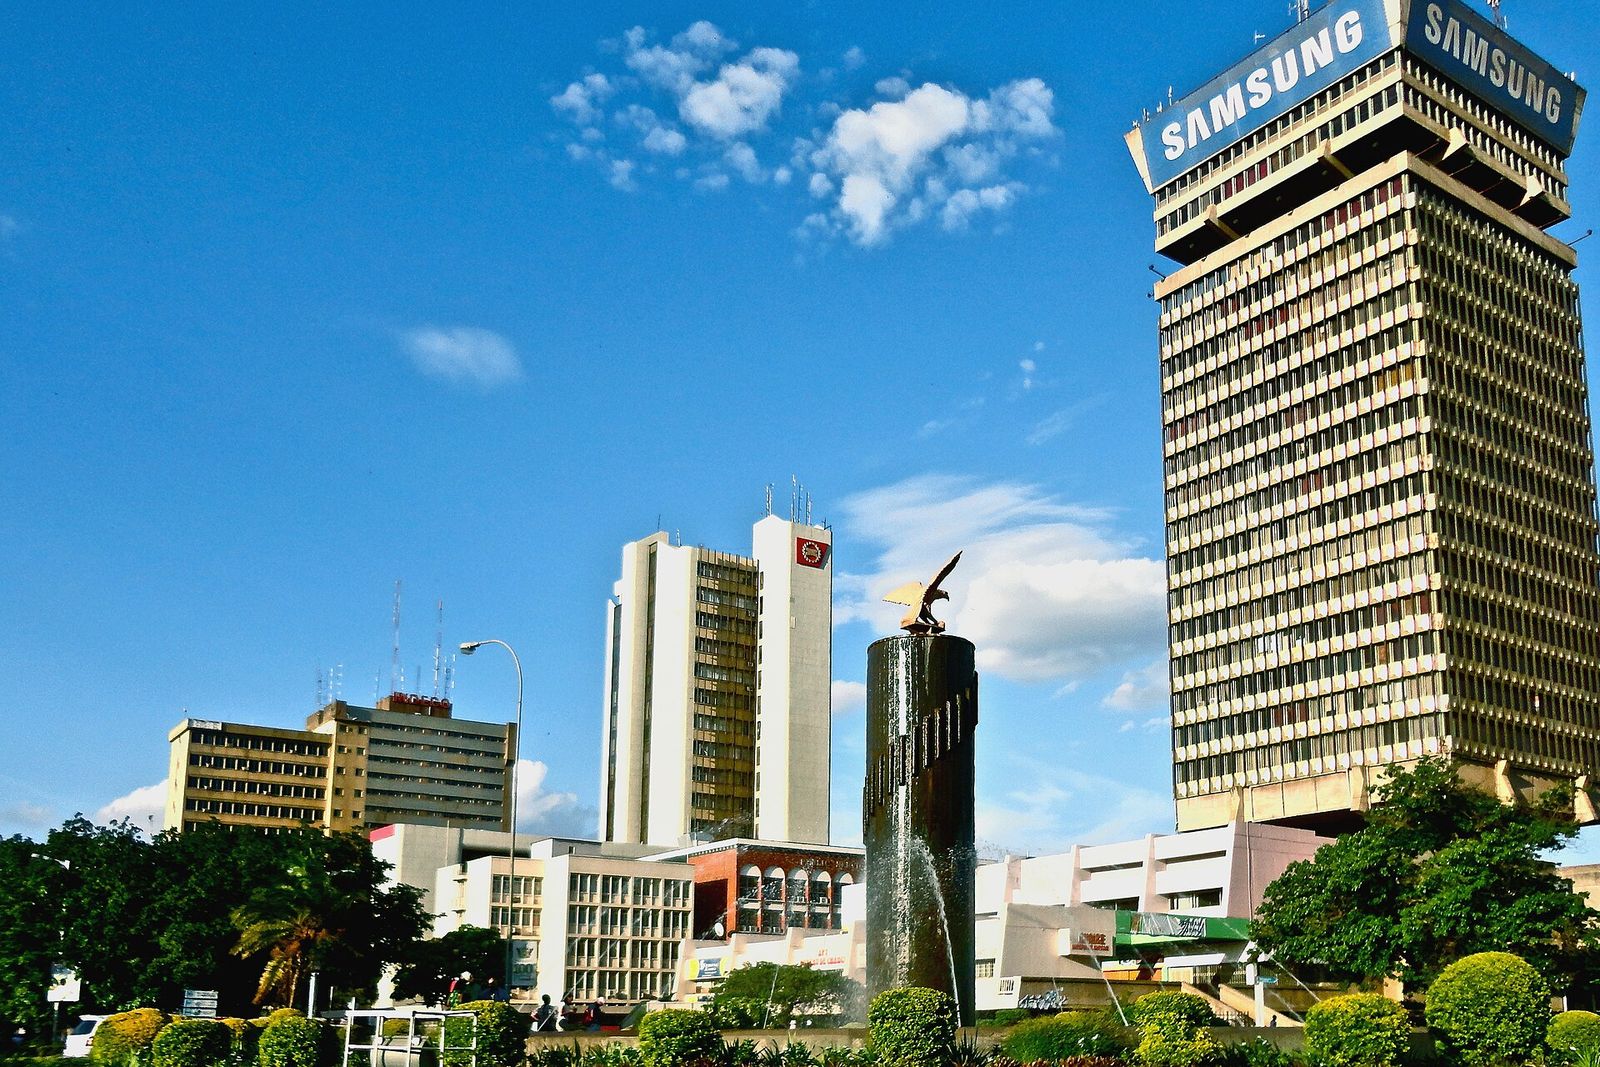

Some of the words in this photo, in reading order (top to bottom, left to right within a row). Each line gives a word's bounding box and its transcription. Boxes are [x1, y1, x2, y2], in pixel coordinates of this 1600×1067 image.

[1161, 10, 1363, 161] SAMSUNG
[1425, 3, 1561, 124] SAMSUNG
[393, 691, 450, 709] INDECO
